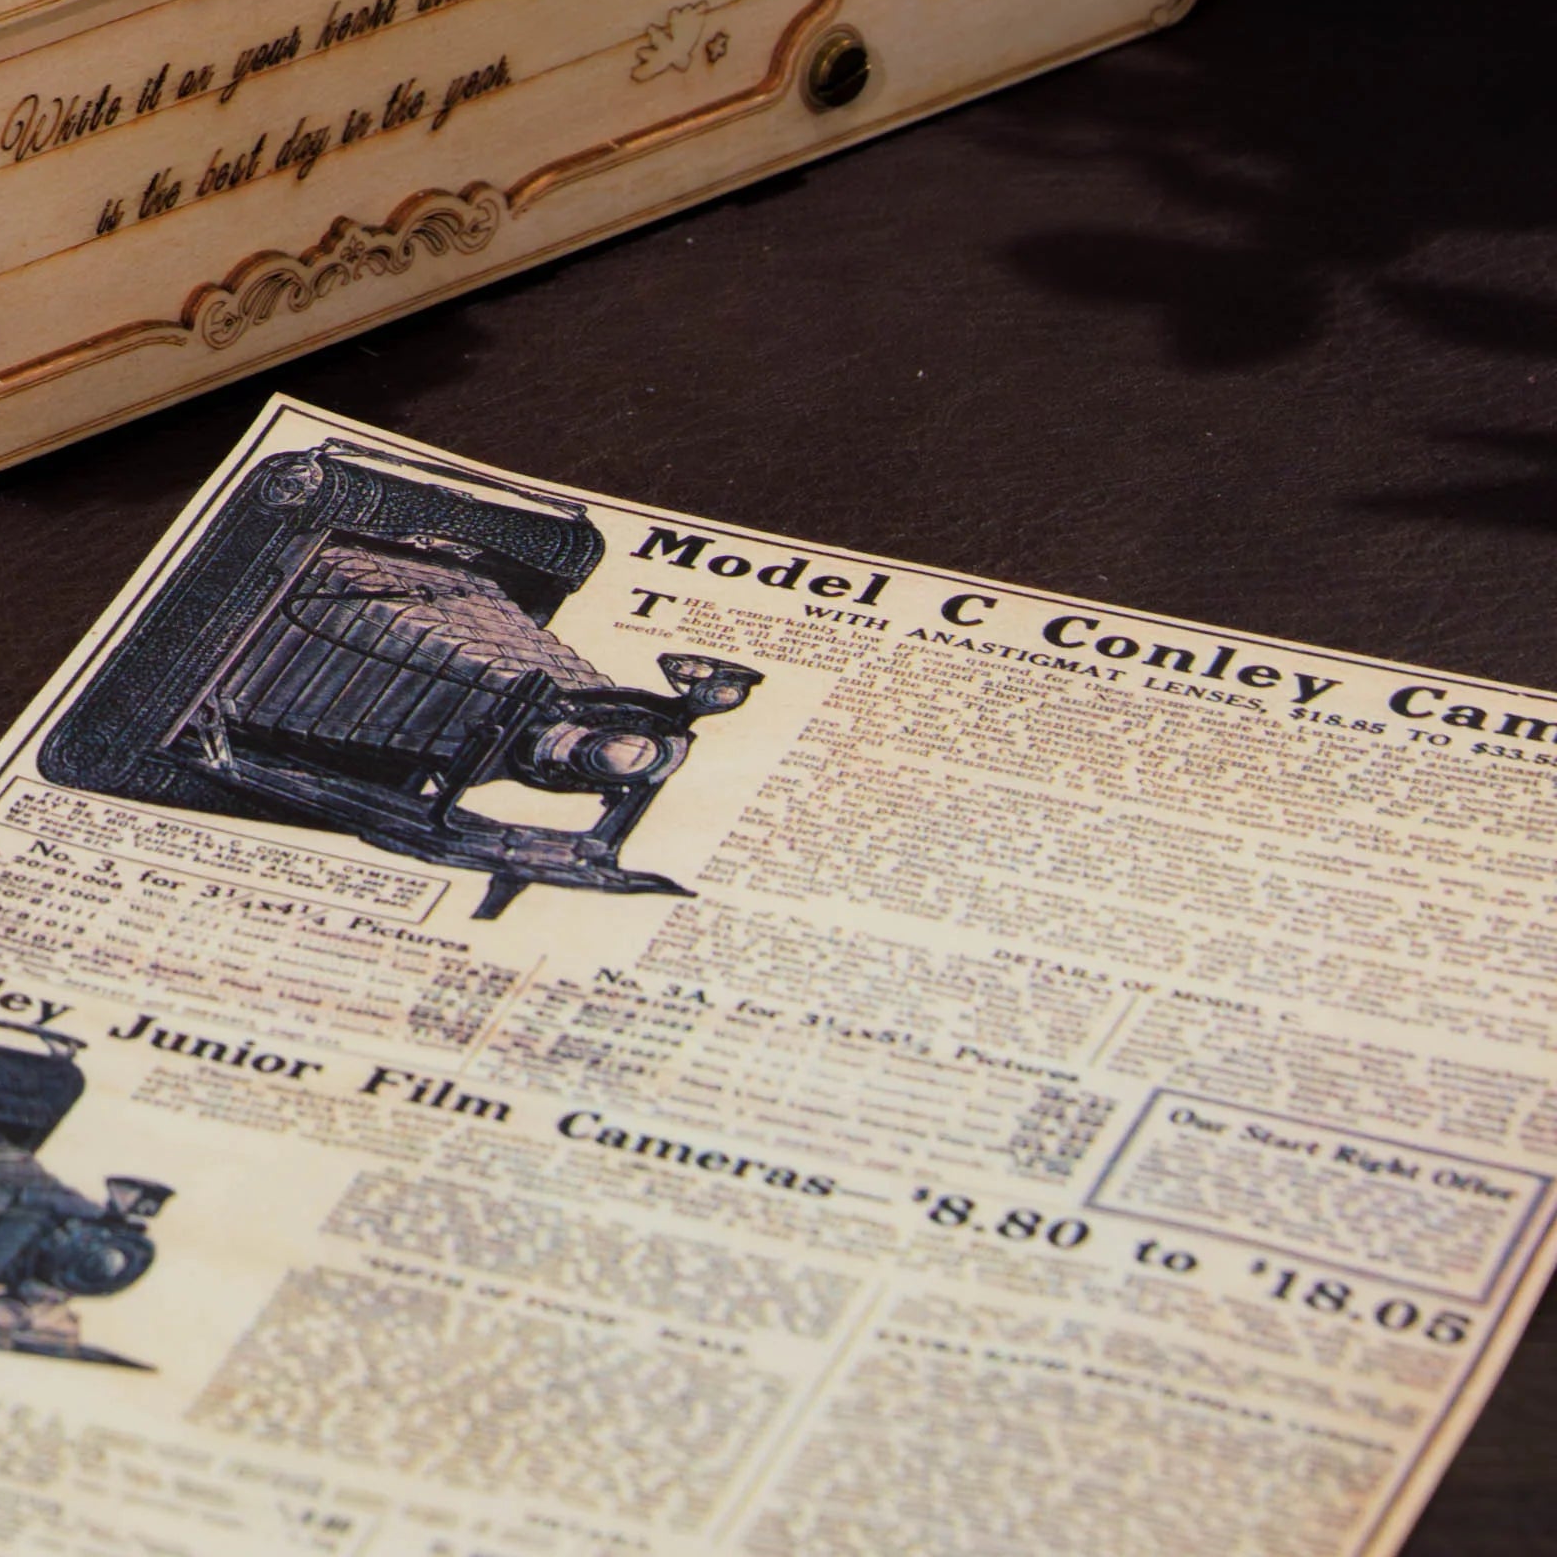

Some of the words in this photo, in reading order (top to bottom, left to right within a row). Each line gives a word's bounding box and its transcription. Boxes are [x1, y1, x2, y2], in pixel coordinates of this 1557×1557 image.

[137, 62, 169, 114] it
[177, 68, 216, 100] on
[220, 26, 301, 104] your
[96, 199, 124, 235] is
[138, 166, 182, 219] the
[196, 133, 267, 197] best
[275, 117, 331, 185] day
[341, 106, 374, 145] in
[383, 78, 424, 129] the
[630, 526, 890, 606] Model
[941, 594, 997, 627] C
[1042, 615, 1343, 705] Conley
[727, 609, 837, 635] remarkably
[851, 631, 882, 643] low
[804, 605, 890, 632] WITH
[905, 628, 1127, 682] ANASTIGMAT
[1143, 676, 1268, 715] LENSES,
[1289, 706, 1387, 736] $18.85
[1407, 727, 1452, 747] TO
[42, 792, 88, 808] FILM
[104, 809, 138, 822] FOR
[156, 822, 211, 840] MODEL
[256, 847, 324, 867] CONLEY
[343, 867, 428, 888] CAMERAS
[106, 818, 178, 839] BOUGHT
[29, 840, 75, 864] No.
[94, 859, 119, 877] 3,
[140, 870, 185, 890] for
[349, 917, 469, 952] Pictures
[993, 948, 1110, 983] DETAILS
[1122, 979, 1158, 994] OF
[736, 998, 779, 1018] for
[956, 1045, 1079, 1082] Pictures
[108, 1015, 324, 1080] Junior
[359, 1066, 512, 1123] Film
[912, 1187, 1090, 1250] $8.80
[1134, 1239, 1197, 1273] to
[1251, 1258, 1472, 1346] $18.05
[1168, 1109, 1229, 1135] Our
[1239, 1124, 1318, 1156] Start
[1332, 1145, 1421, 1181] Right
[1431, 1169, 1517, 1202] Offer
